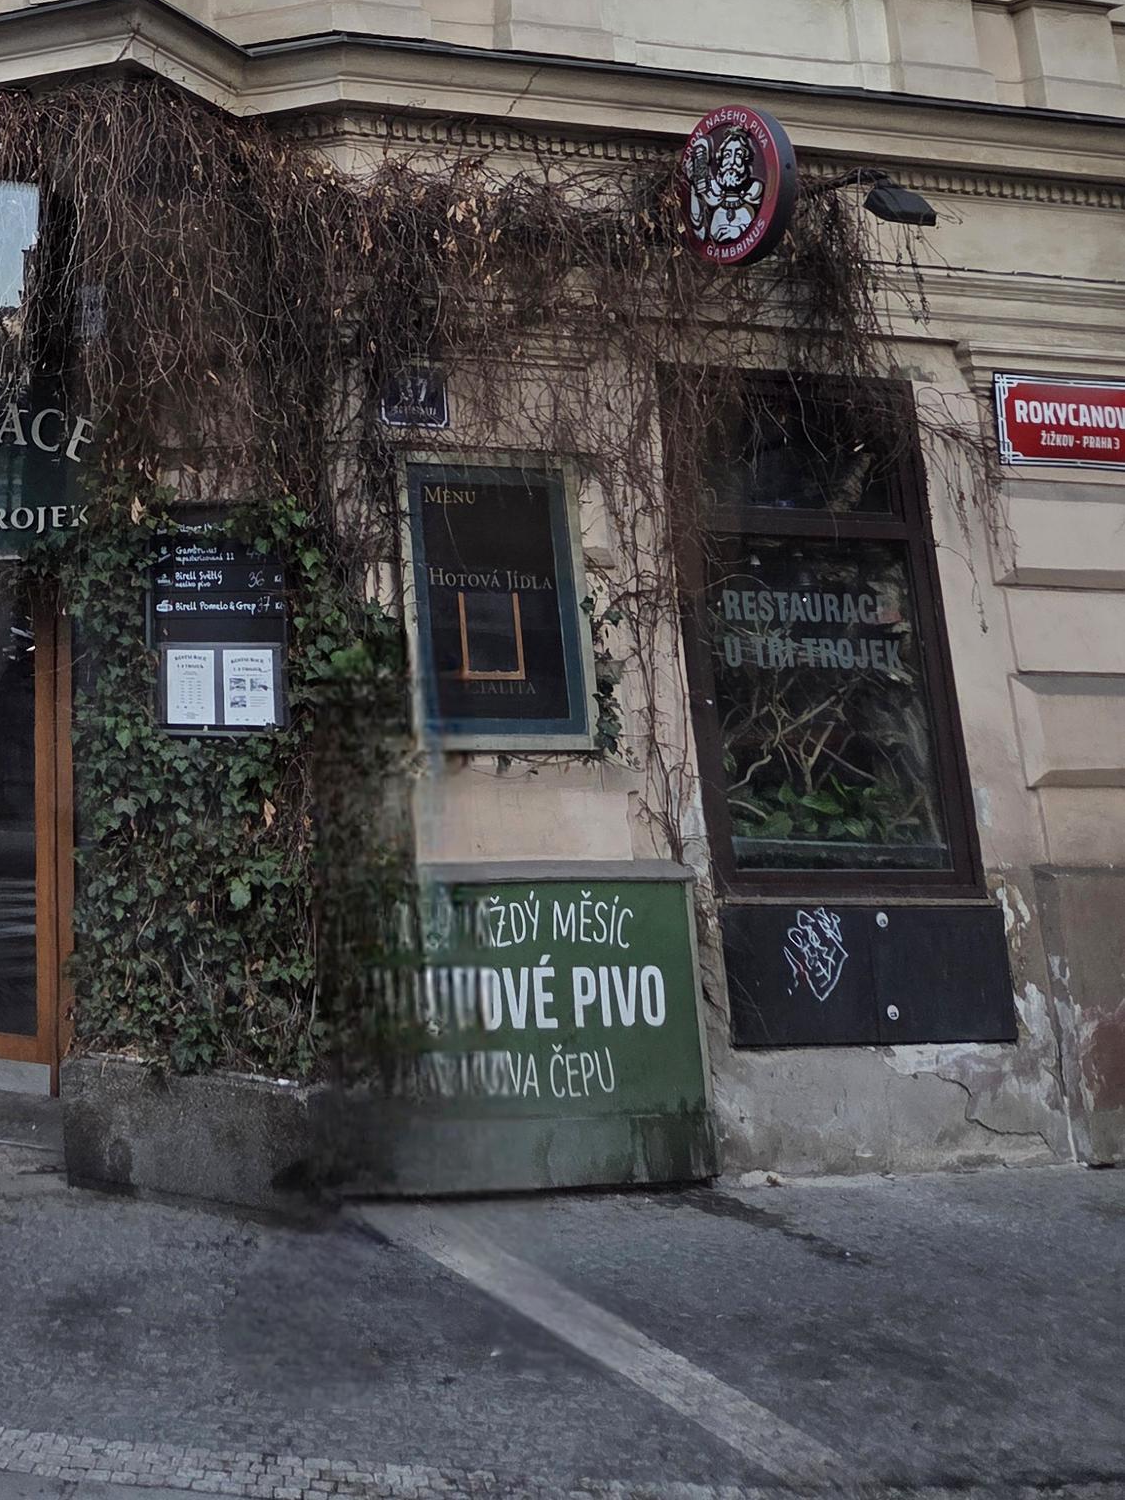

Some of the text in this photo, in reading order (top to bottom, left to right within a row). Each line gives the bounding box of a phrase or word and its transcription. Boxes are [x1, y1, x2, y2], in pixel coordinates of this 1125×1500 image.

[705, 109, 748, 130] NAŠEHO
[751, 121, 770, 149] PIVA
[706, 217, 767, 259] GAMBRINUS
[1040, 429, 1075, 448] ŽIŽKOV
[1082, 435, 1113, 449] PRAHA
[1113, 437, 1121, 450] 3
[423, 485, 475, 504] MENU
[175, 571, 197, 581] Birell
[199, 570, 224, 585] Světlý
[248, 570, 265, 589] 36
[429, 566, 554, 591] HOTOVÁ JÍDLA
[175, 602, 197, 611] Birell
[200, 602, 228, 611] Pomelo
[236, 602, 257, 615] Grep
[723, 635, 743, 668] U
[801, 636, 905, 670] TROJEK
[552, 890, 634, 949] MĚSÍC
[572, 965, 666, 1028] PIVO
[549, 1043, 616, 1099] ČEPU
